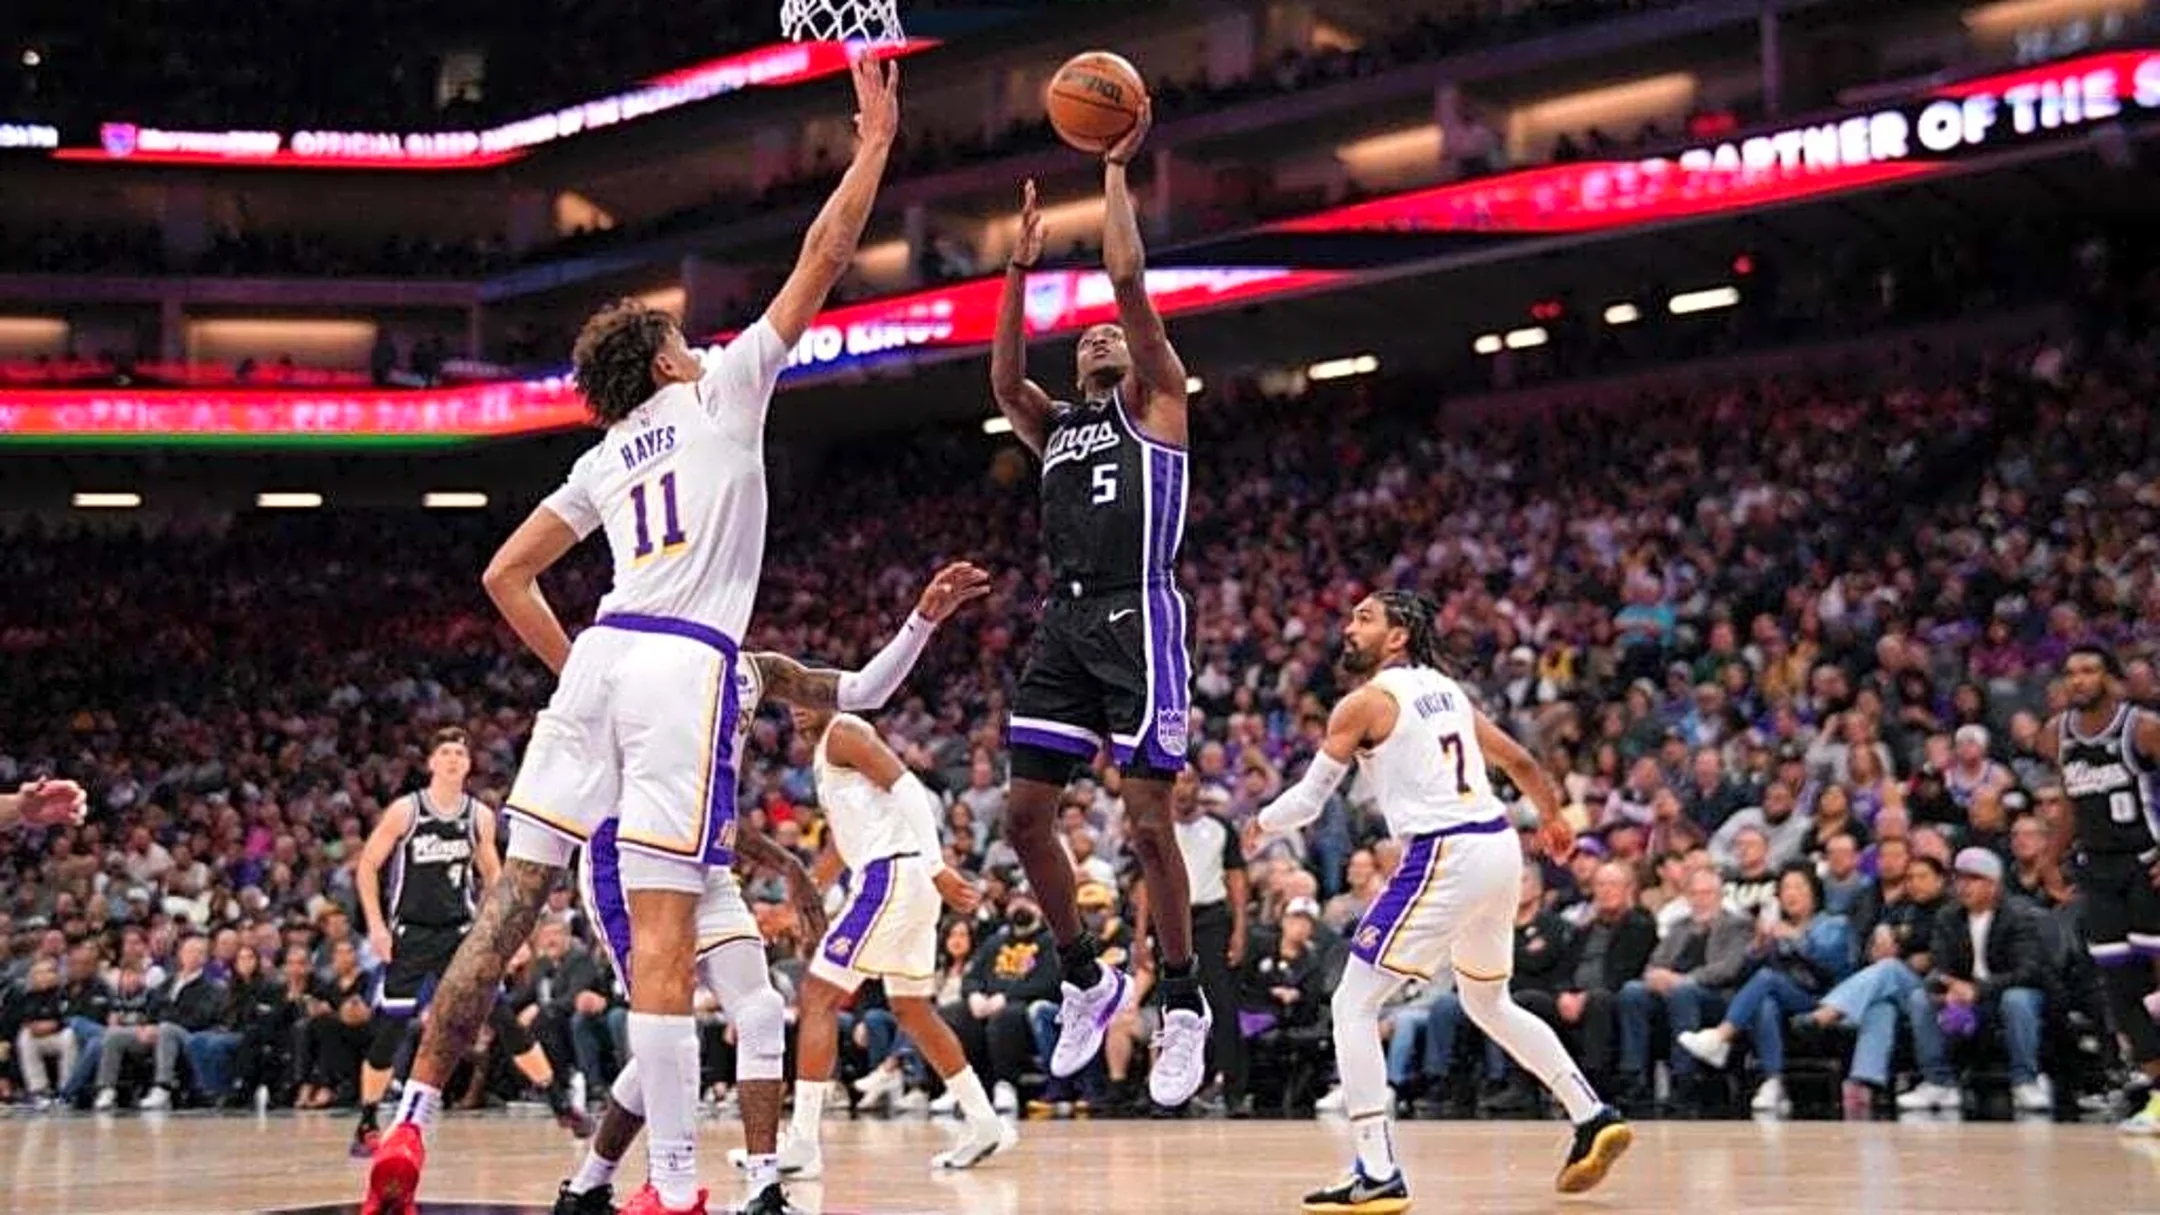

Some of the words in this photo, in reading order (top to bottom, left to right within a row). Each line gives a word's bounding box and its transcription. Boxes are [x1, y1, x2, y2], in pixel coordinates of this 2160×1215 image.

[1679, 110, 1909, 183] PARTNER
[1917, 92, 1997, 151] OF
[2003, 68, 2121, 134] THE
[1092, 463, 1118, 504] 5
[630, 471, 688, 565] 11
[1438, 731, 1473, 797] 7
[2109, 792, 2136, 823] 0
